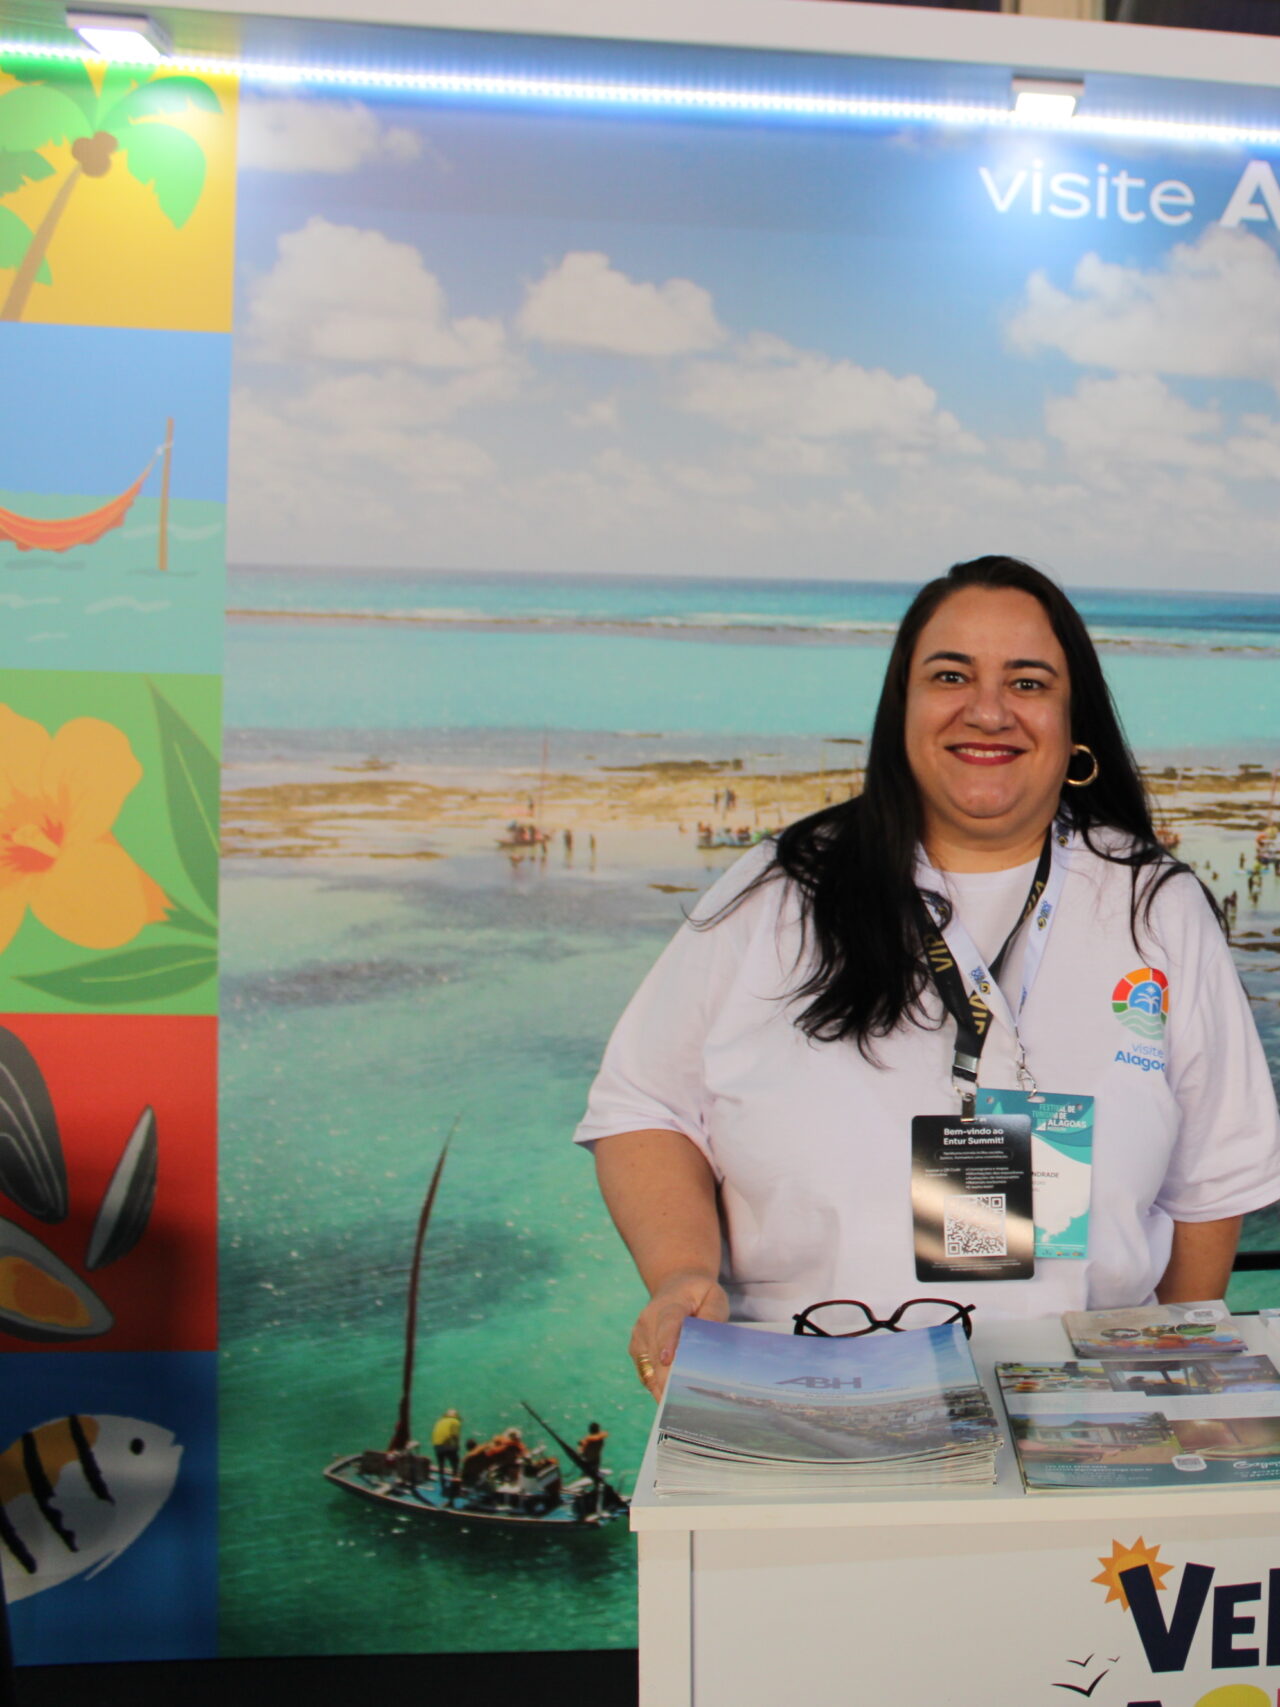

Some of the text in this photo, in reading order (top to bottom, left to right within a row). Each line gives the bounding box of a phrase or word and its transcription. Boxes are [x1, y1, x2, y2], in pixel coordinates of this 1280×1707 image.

[978, 159, 1196, 226] visite
[1114, 1050, 1167, 1072] Alago
[1047, 1119, 1087, 1129] ALAGOAS
[943, 1127, 992, 1136] Bem-vindo
[943, 1137, 1005, 1145] Entur Summit!
[774, 1375, 862, 1389] ABH
